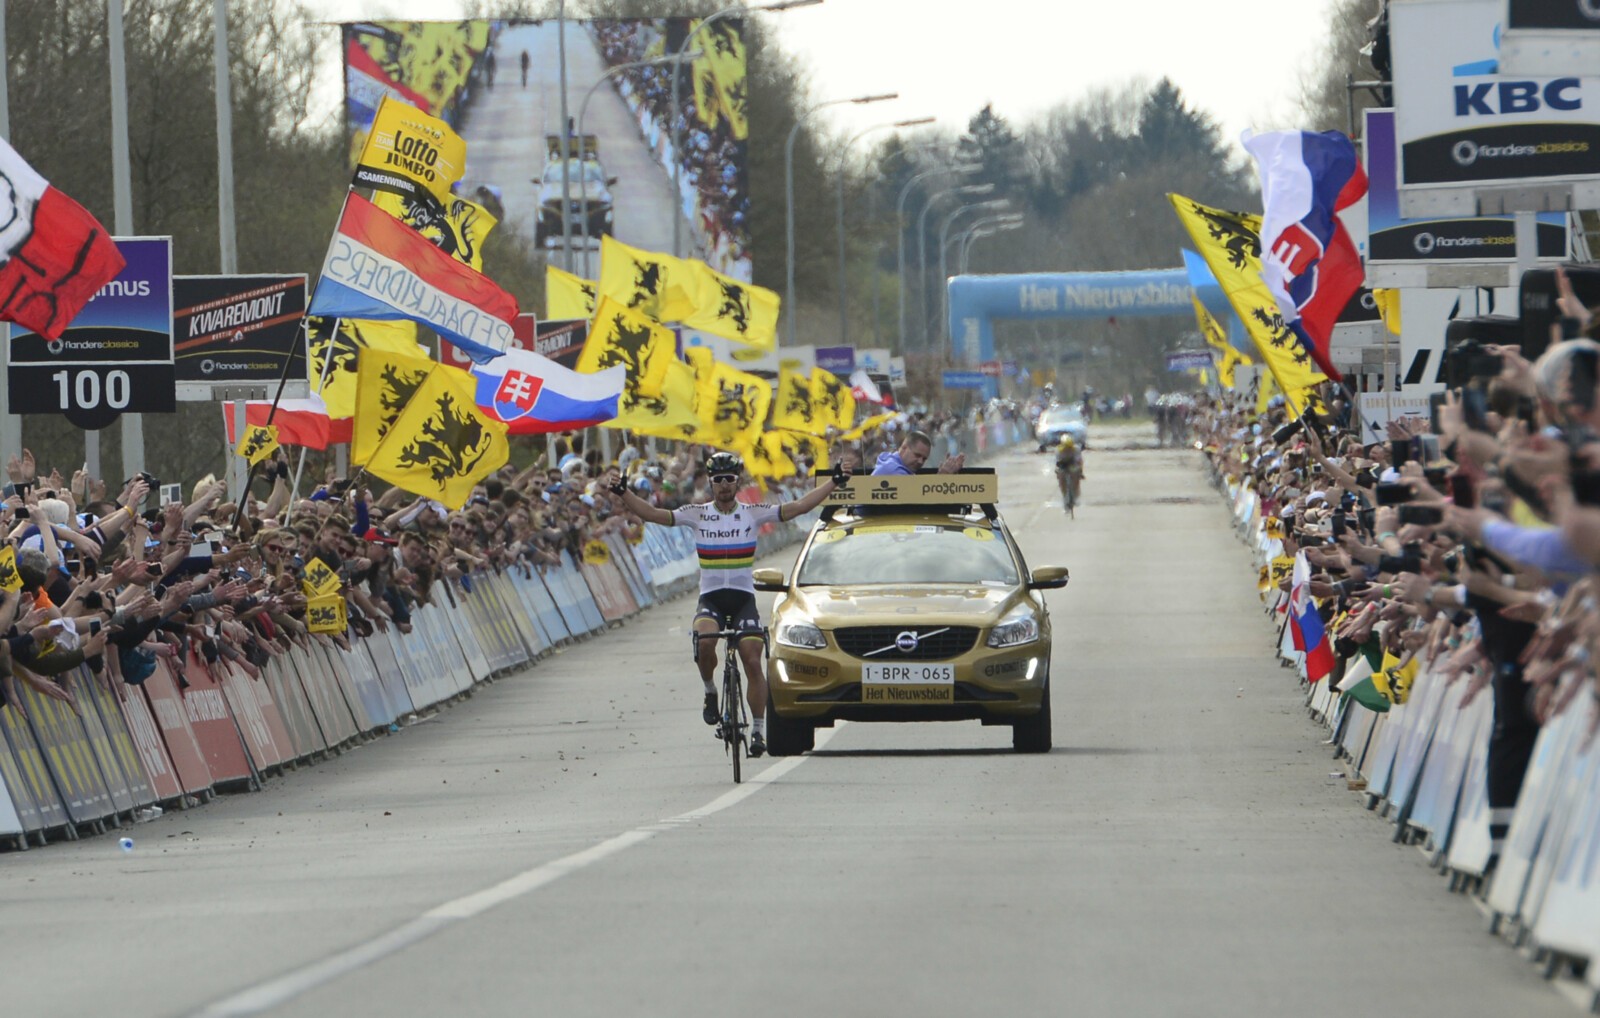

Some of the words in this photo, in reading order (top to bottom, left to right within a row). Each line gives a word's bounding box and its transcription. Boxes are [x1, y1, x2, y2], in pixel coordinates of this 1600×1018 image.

[1454, 77, 1582, 117] KBC
[394, 129, 438, 167] Lotto
[1478, 140, 1590, 158] flandersclassics
[384, 152, 435, 183] JUMBO
[1436, 233, 1516, 247] flandersclassi
[89, 279, 151, 302] imus
[1020, 284, 1058, 311] Het
[189, 291, 286, 338] KWAREMONT
[64, 340, 139, 350] flandersclassics
[215, 361, 279, 371] flandersclassics
[53, 369, 131, 410] 100
[829, 492, 856, 501] KBC
[871, 492, 898, 501] KBC
[922, 481, 985, 497] proximus
[699, 528, 741, 539] Tinkoff
[866, 687, 885, 700] Het
[887, 686, 950, 700] Nieuwsblad
